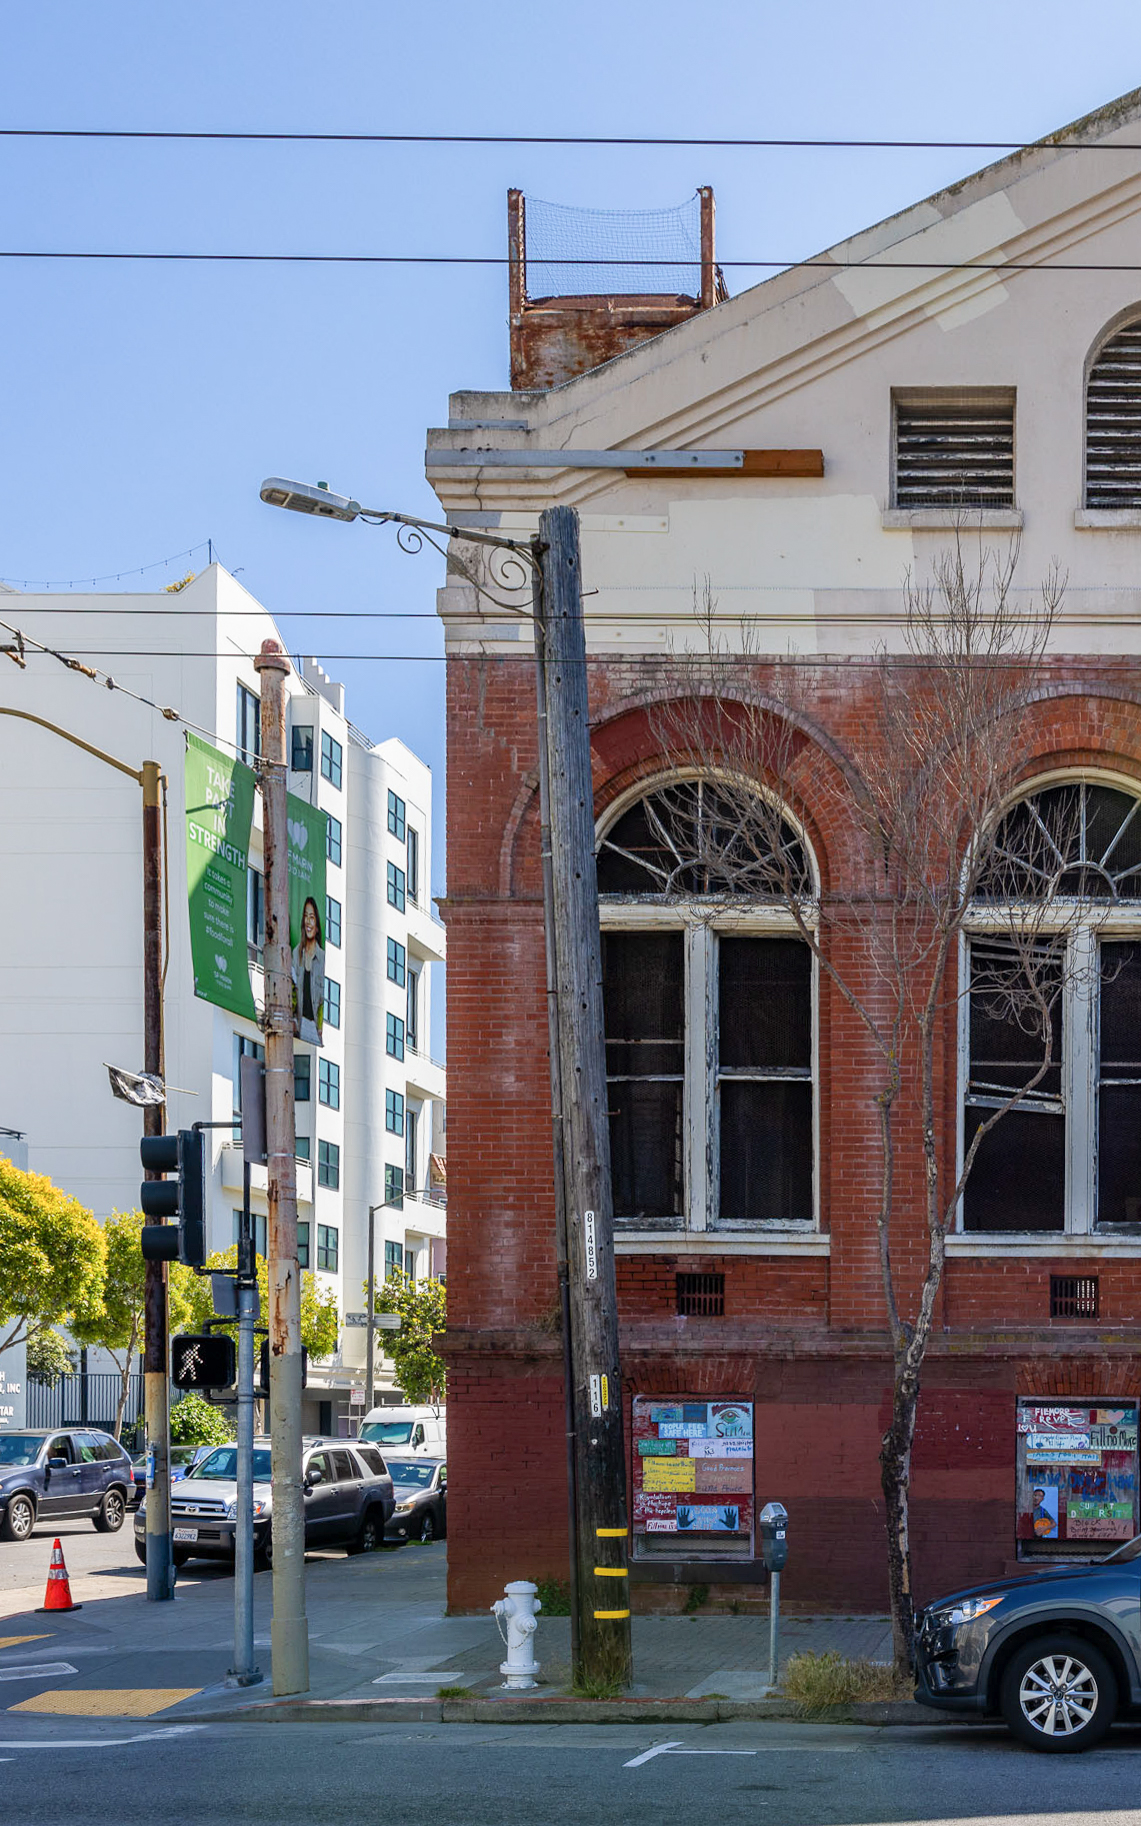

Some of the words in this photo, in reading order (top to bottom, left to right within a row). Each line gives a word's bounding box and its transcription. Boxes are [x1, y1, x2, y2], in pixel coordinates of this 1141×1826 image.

[206, 765, 236, 799] TAKE
[205, 787, 235, 819] PART
[213, 815, 227, 836] IN
[189, 821, 246, 870] STRENGTH
[211, 869, 226, 886] takes
[204, 881, 233, 907] community
[208, 898, 215, 908] to
[215, 903, 231, 918] make
[203, 911, 215, 924] sure
[215, 915, 231, 934] there
[205, 925, 234, 948] #foodforall
[587, 1212, 595, 1279] 814852
[7, 1383, 21, 1395] INC
[702, 1462, 718, 1472] Good
[1071, 1510, 1127, 1518] DIVERSITY
